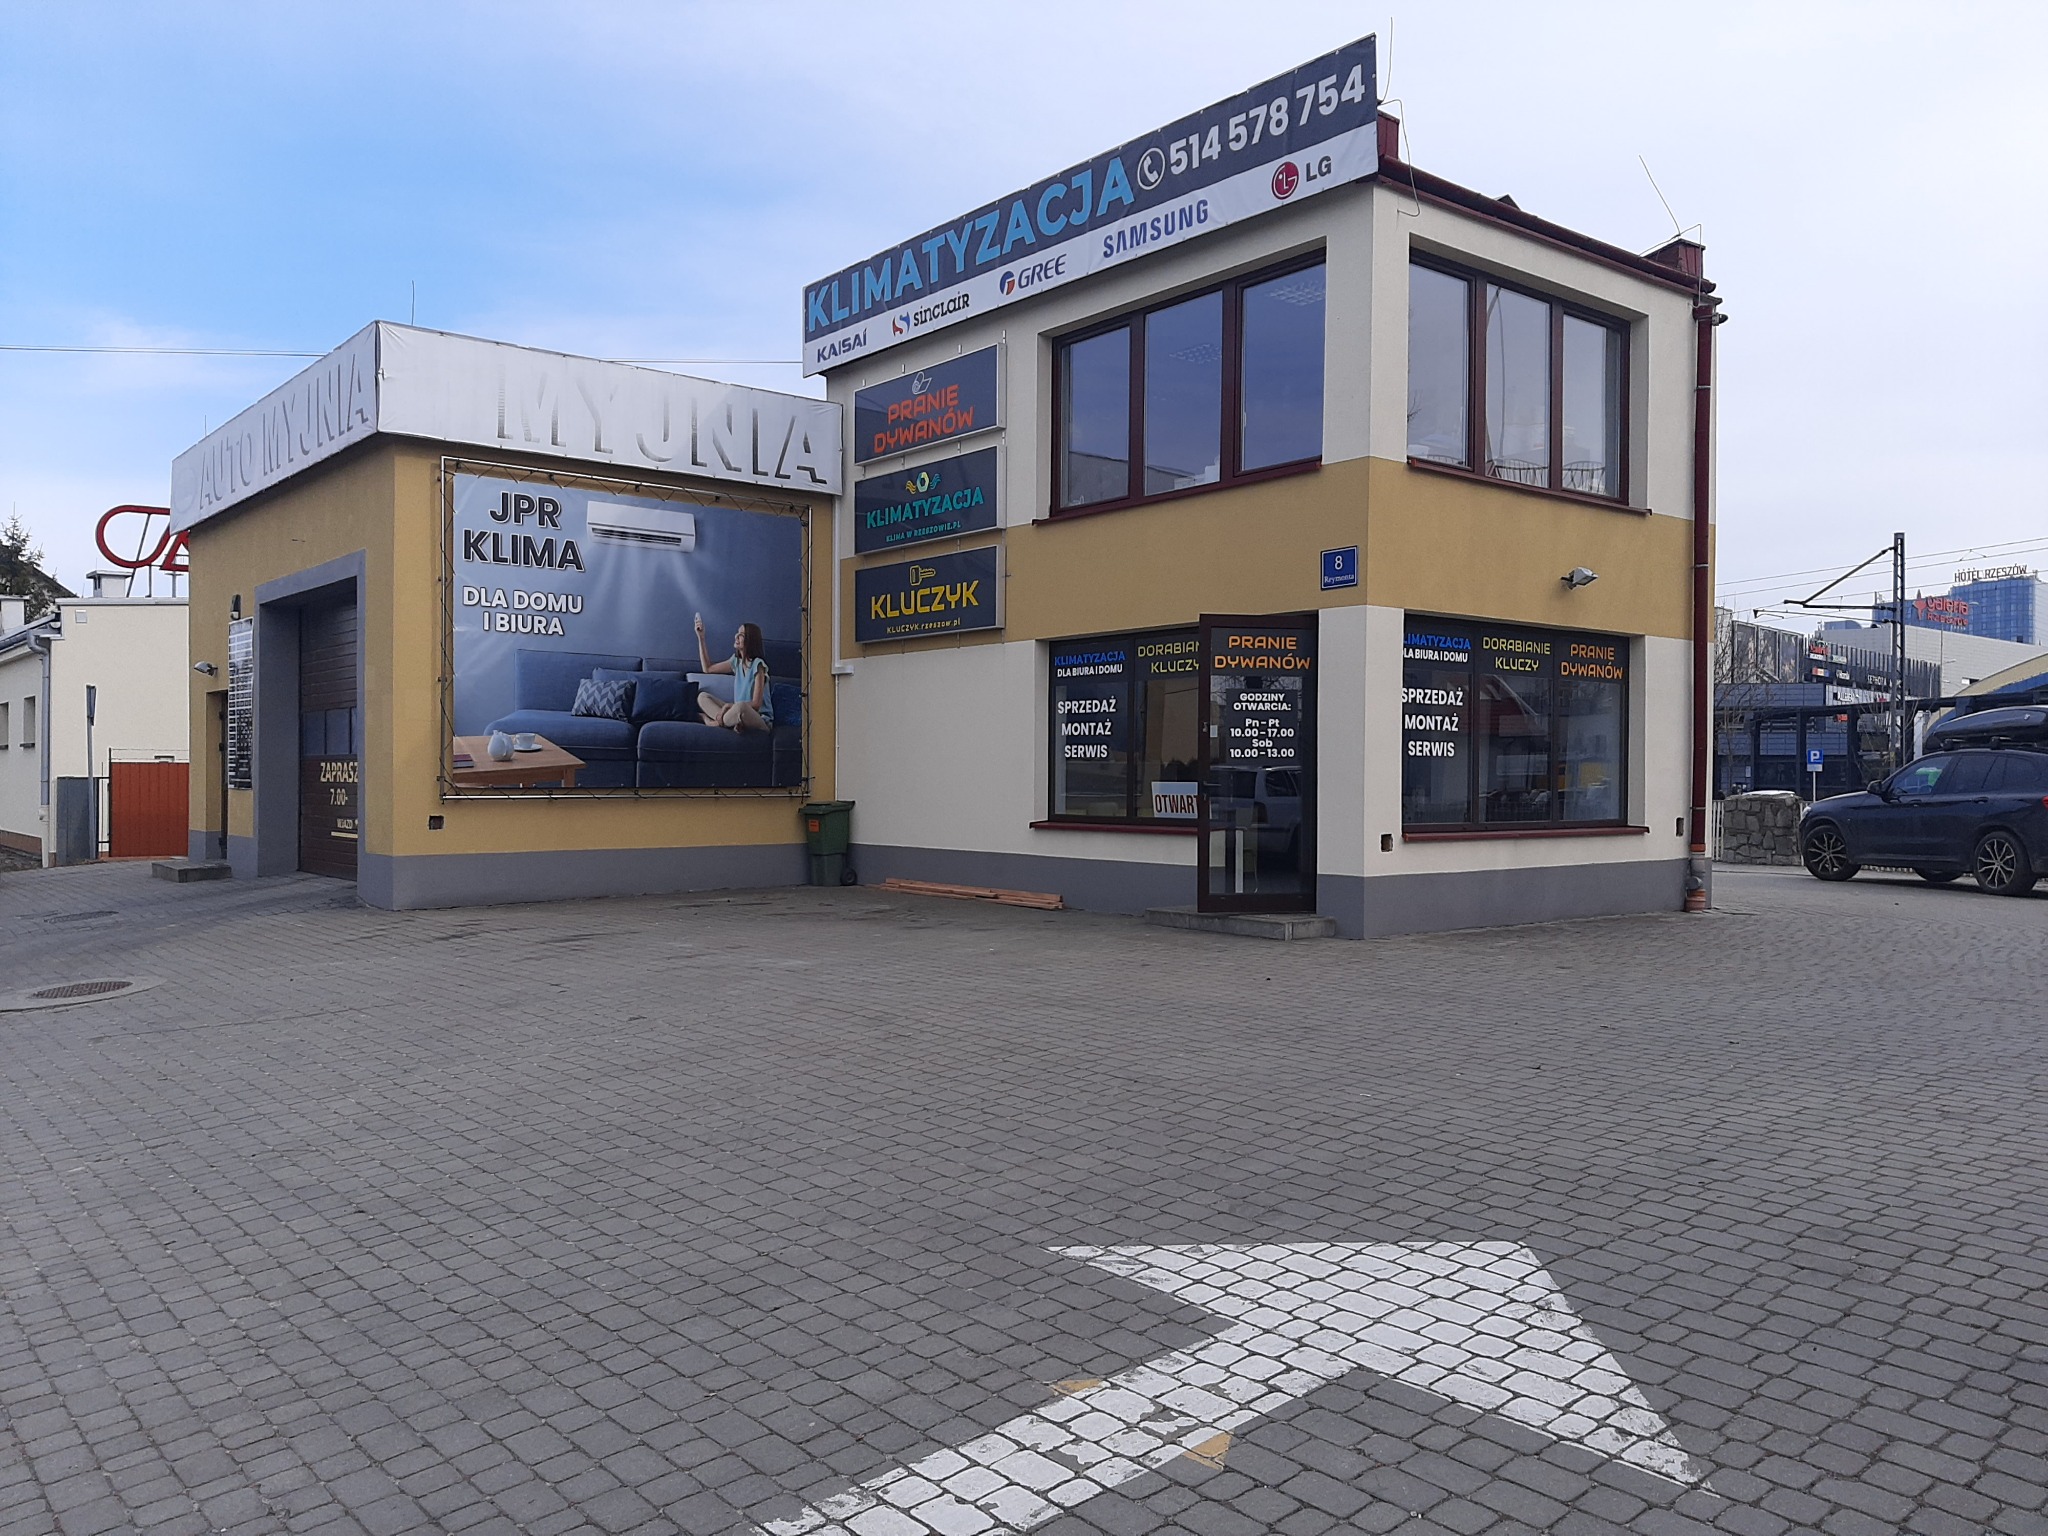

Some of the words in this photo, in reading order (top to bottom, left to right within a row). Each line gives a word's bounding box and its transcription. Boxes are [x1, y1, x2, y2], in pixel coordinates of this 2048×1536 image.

[808, 156, 1135, 332] KLIMATYZACJA
[1169, 124, 1222, 175] 514
[1228, 96, 1289, 151] 578
[1296, 64, 1365, 127] 754
[817, 328, 868, 363] KAISAI
[1018, 253, 1068, 289] GREE
[1103, 199, 1209, 258] SAMSUNG
[1306, 155, 1332, 182] LG
[887, 383, 960, 424] PRANIE
[873, 406, 975, 454] DYWANÓW
[199, 430, 252, 510] AUTO
[489, 490, 562, 530] JPR
[866, 486, 984, 529] KLIMATYZACJA
[885, 531, 905, 542] KLIMA
[906, 530, 913, 538] W
[463, 528, 585, 572] KLIMA
[1334, 555, 1343, 570] 8
[1324, 574, 1355, 584] Reymonta
[1954, 569, 1981, 582] HOTEL
[462, 586, 508, 608] DLA
[513, 590, 583, 614] DOMU
[871, 580, 980, 620] KLUCZYK
[483, 611, 490, 631] I
[495, 613, 564, 635] BIURA
[1228, 635, 1297, 650] PRANIE
[1482, 637, 1551, 655] DORABIANIE
[1054, 650, 1126, 666] KLIMATYZACJA
[1414, 648, 1440, 661] BIURA
[1443, 651, 1469, 663] DOMU
[1570, 643, 1615, 660] PRANIE
[1214, 653, 1310, 669] DYWANÓW
[1495, 656, 1539, 672] KLUCZY
[1057, 667, 1072, 678] DLA
[1072, 665, 1095, 676] BIURA
[1098, 664, 1123, 674] DOMU
[1560, 661, 1624, 680] DYWANÓW
[1057, 695, 1117, 714] SPRZEDAŻ
[1239, 693, 1285, 702] GODZINY
[1401, 687, 1464, 706] SPRZEDAŻ
[1233, 702, 1291, 711] OTWARCIA:
[1061, 719, 1112, 736] MONTAŻ
[1245, 718, 1259, 727] Pn
[1268, 718, 1280, 727] Pt
[1405, 713, 1459, 732] MONTAŻ
[1064, 744, 1108, 758] SERWIS
[1252, 739, 1273, 748] Sob
[1408, 740, 1455, 757] SERWIS
